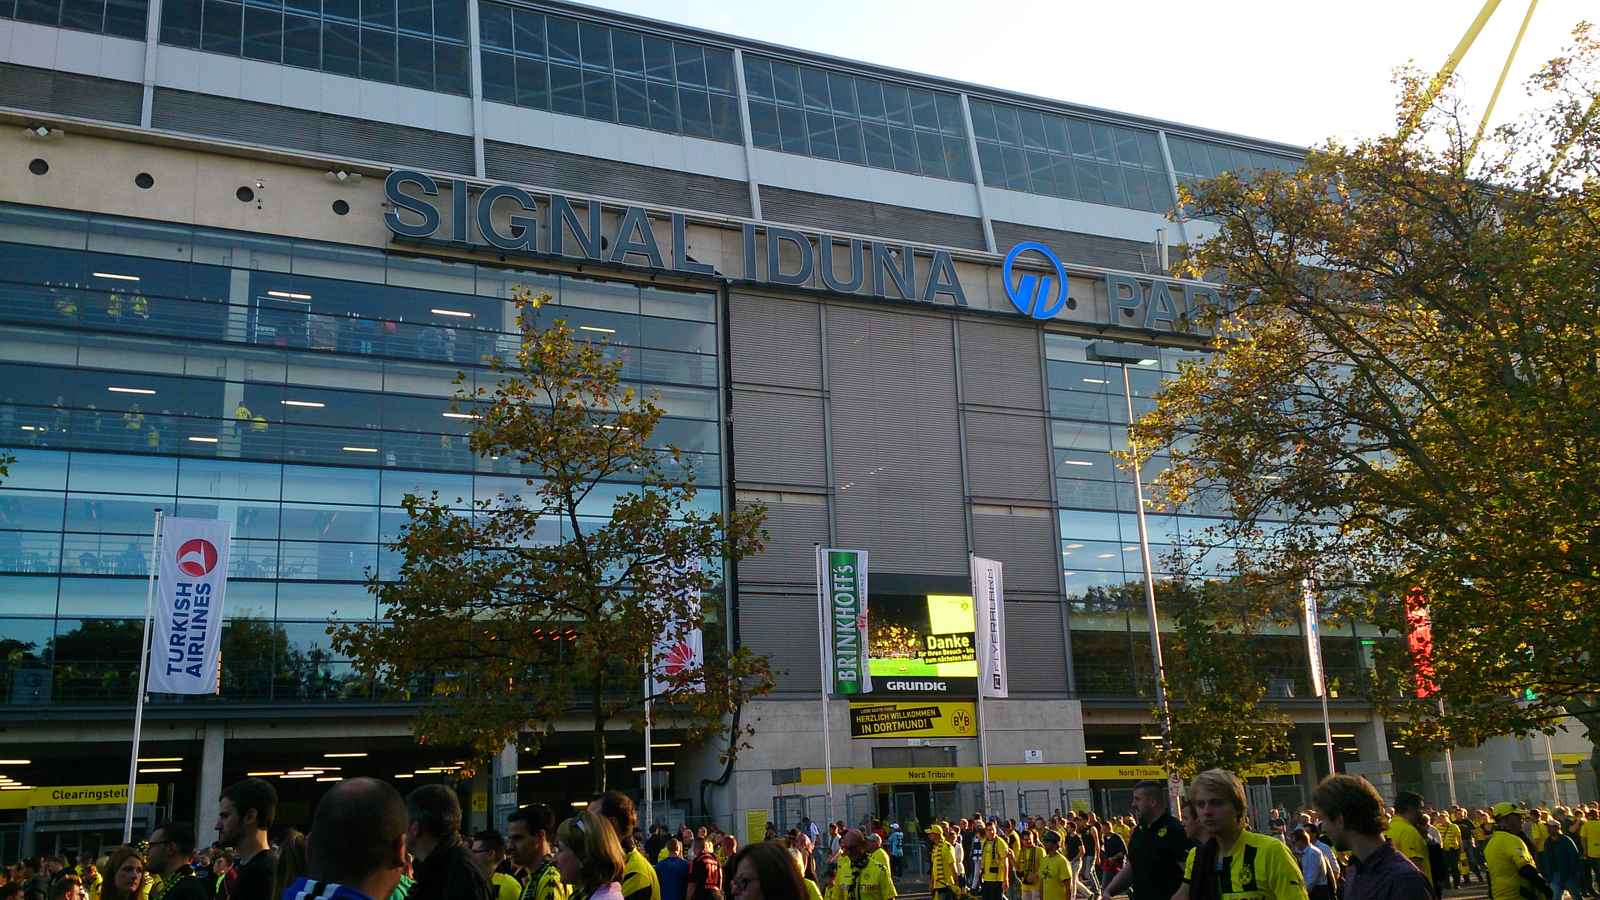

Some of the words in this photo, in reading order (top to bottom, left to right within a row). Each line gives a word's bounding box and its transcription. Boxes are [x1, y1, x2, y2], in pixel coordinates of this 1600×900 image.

[384, 169, 715, 276] SIGNAL
[742, 222, 968, 306] IDUNA
[166, 582, 193, 676] TURKISH
[186, 582, 212, 678] AIRLINES
[927, 634, 970, 650] Danke
[856, 712, 890, 723] HERZLICH
[890, 709, 937, 720] WILLKOMMEN
[953, 711, 970, 727] BVB
[861, 723, 872, 734] IN
[873, 719, 928, 733] DORTMUND!
